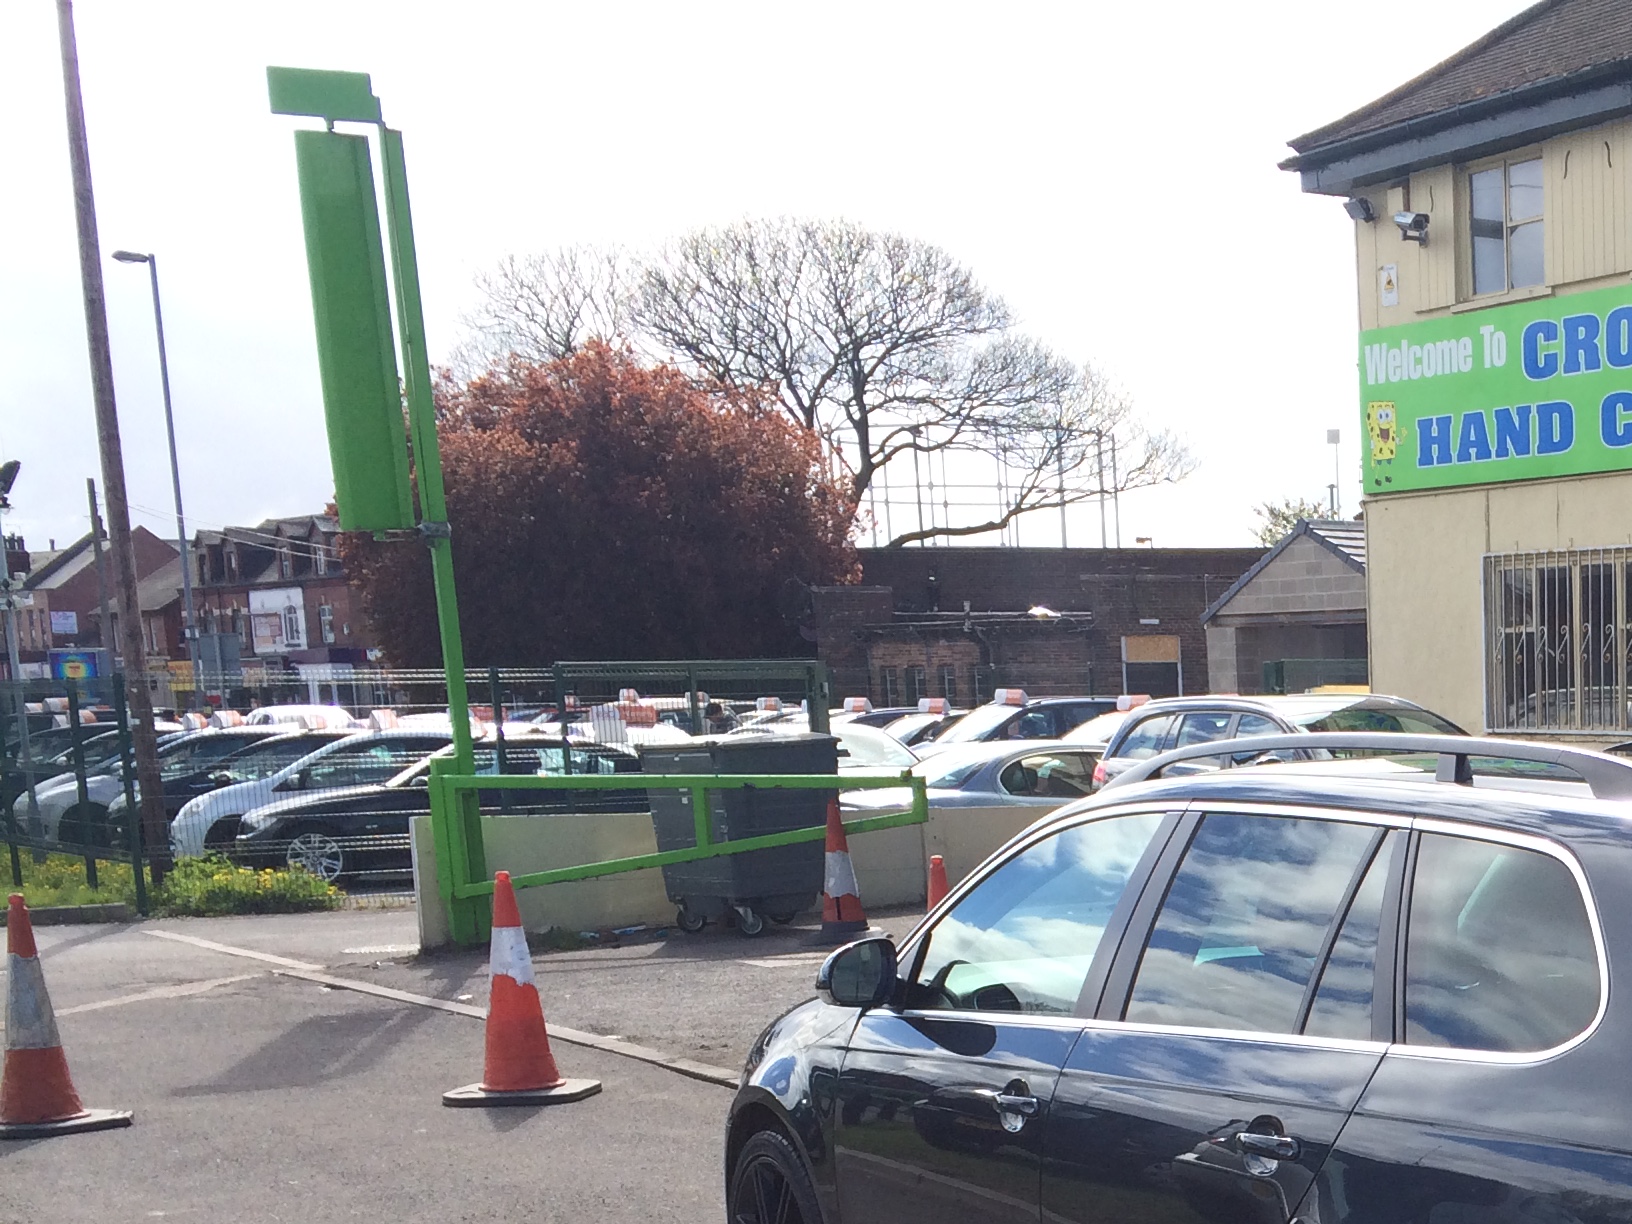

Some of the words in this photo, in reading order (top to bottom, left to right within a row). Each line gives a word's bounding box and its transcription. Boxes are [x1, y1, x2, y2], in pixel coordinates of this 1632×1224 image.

[1363, 336, 1473, 387] Welcome
[1478, 325, 1508, 370] To
[1415, 399, 1575, 468] HAND
